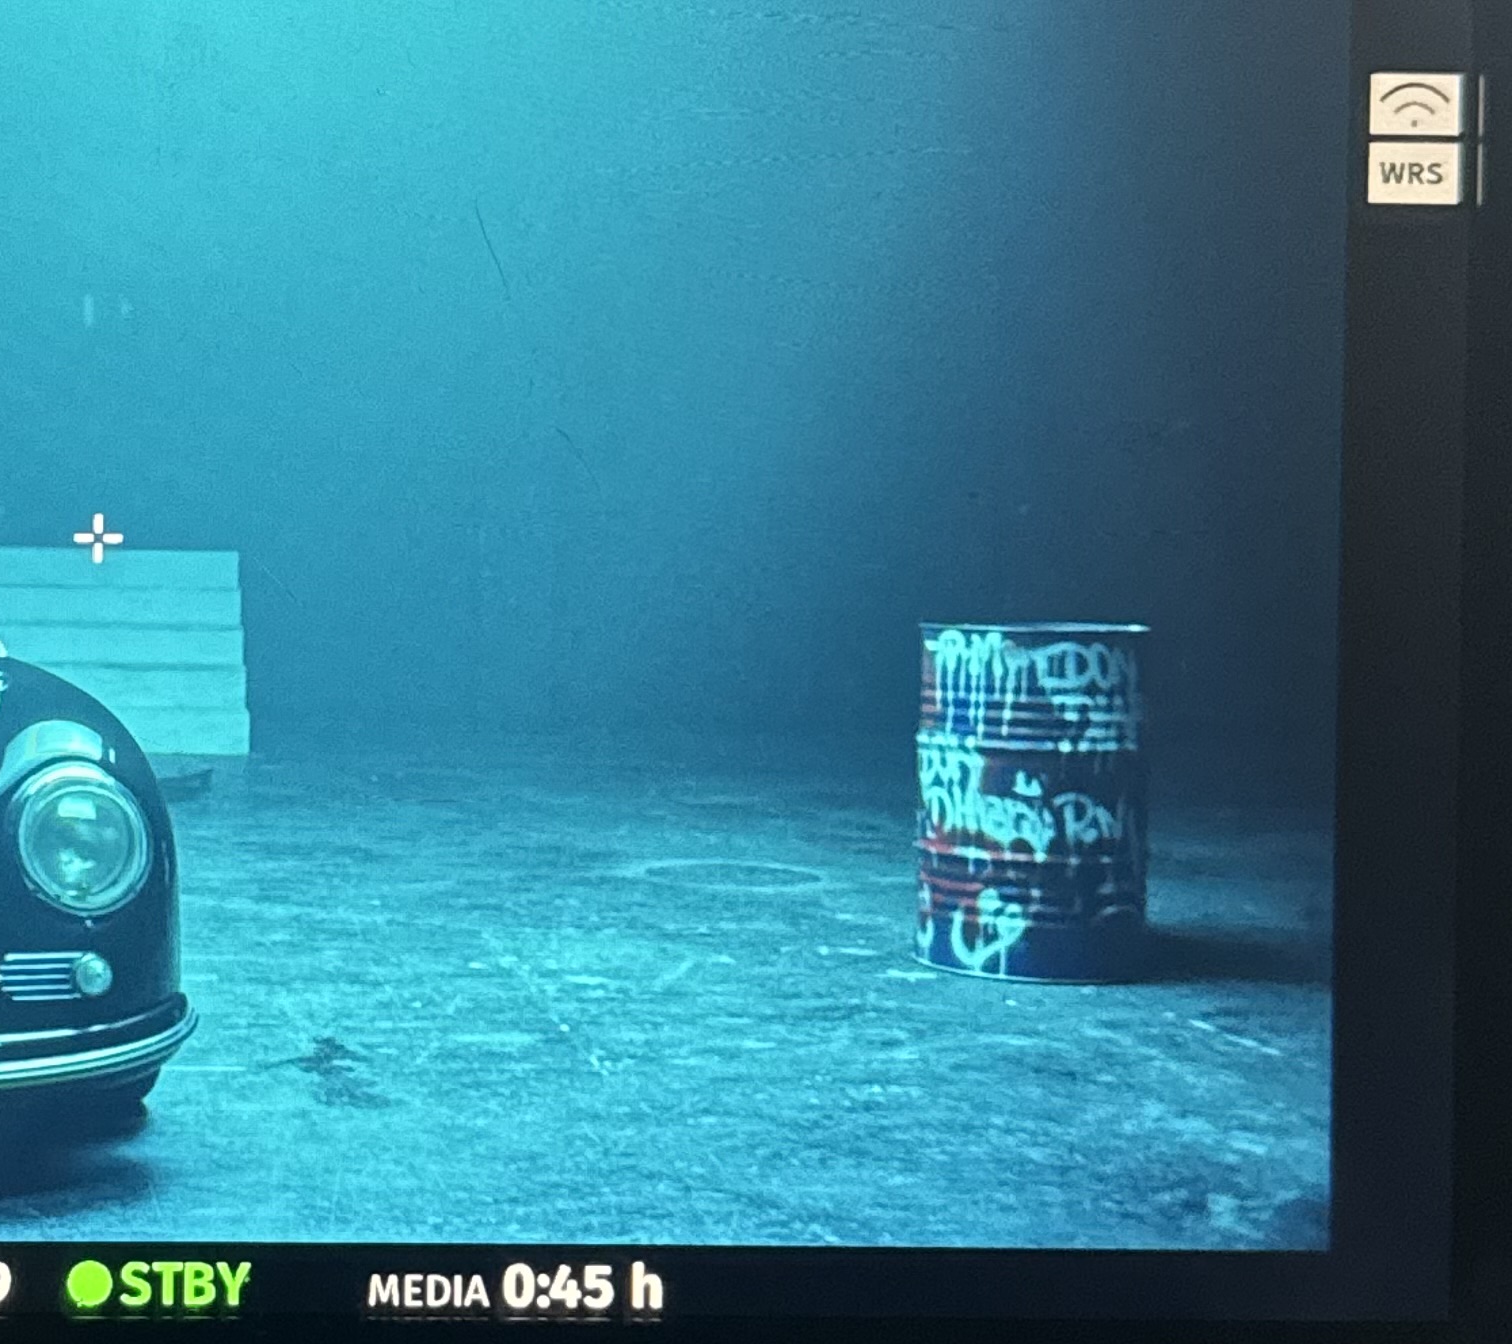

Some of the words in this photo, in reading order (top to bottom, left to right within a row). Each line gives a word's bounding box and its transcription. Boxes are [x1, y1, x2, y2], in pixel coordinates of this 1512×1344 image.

[1379, 161, 1444, 185] WRS
[119, 1260, 252, 1309] STBY
[367, 1273, 491, 1308] MEDIA
[502, 1262, 615, 1310] 0:45
[630, 1260, 664, 1311] h
